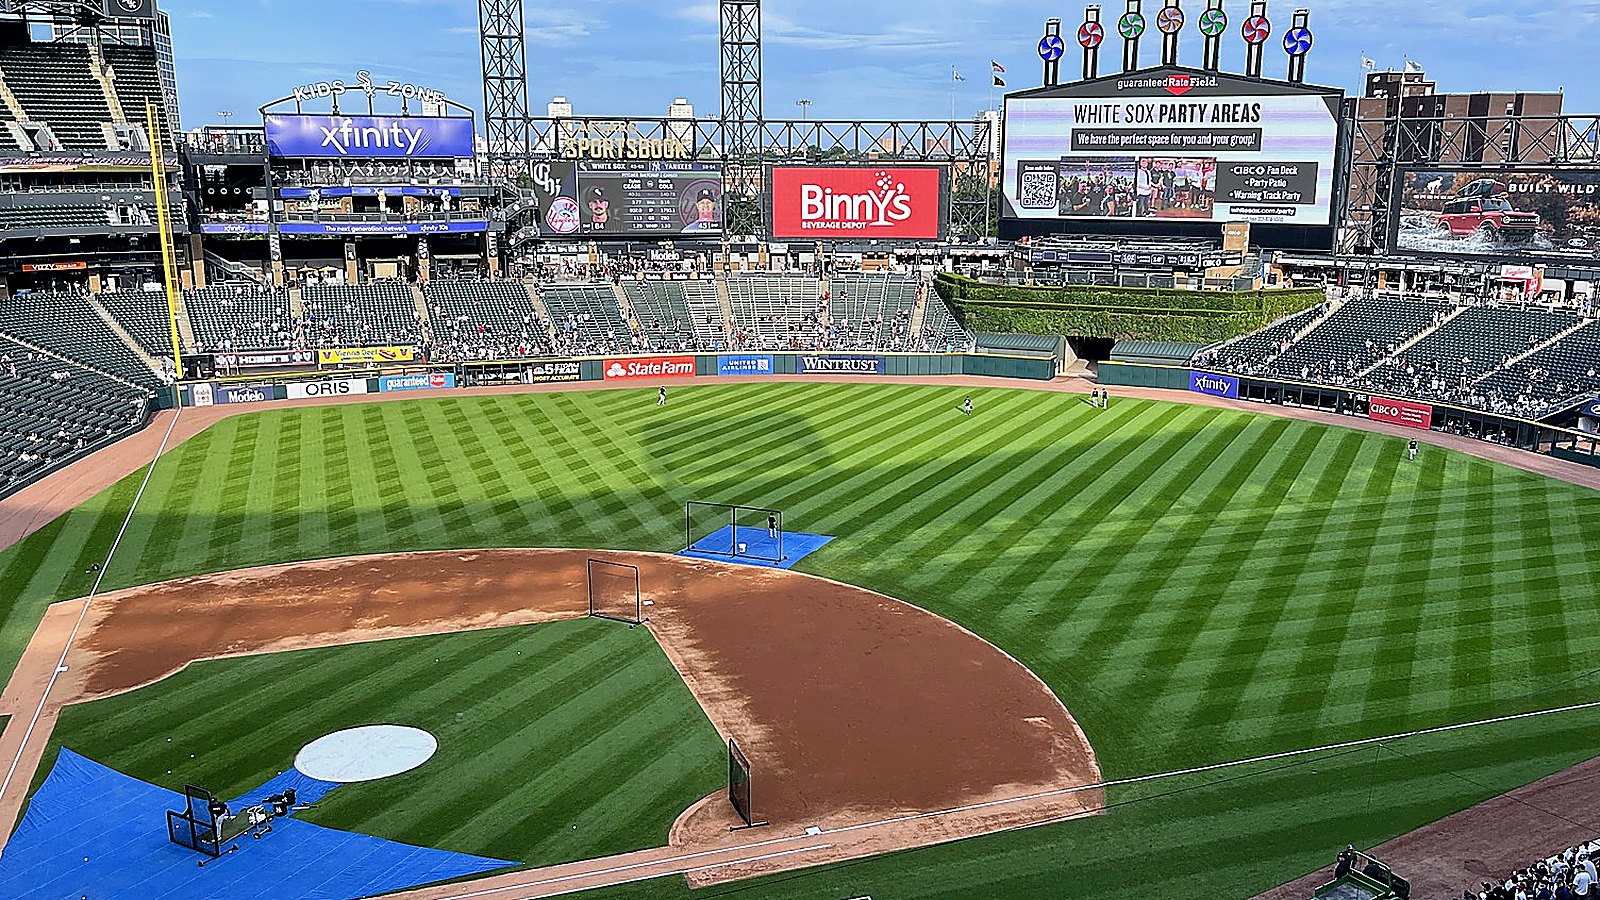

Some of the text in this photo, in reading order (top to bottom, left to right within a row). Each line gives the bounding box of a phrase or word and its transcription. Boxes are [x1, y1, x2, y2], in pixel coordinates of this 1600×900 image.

[1117, 77, 1168, 90] guaranteed
[1168, 77, 1188, 87] Rate
[294, 80, 447, 105] KIDS ZONE
[1074, 103, 1260, 123] WHITE SOX PARTY AREAS
[320, 119, 423, 155] xfinity
[1077, 133, 1256, 147] We have the perfect space for you and your group!
[566, 138, 690, 159] SPORTSBOOK
[1233, 166, 1298, 175] CIBC Fan Deck
[1249, 178, 1287, 188] Party Patio
[1508, 183, 1552, 193] BUILT
[1234, 190, 1302, 202] Warning Track Party
[650, 249, 679, 261] Modelo
[31, 263, 55, 271] VIZZY
[545, 363, 554, 375] 5
[627, 361, 693, 375] State Farm
[802, 356, 879, 371] WINTRUST
[305, 381, 350, 396] ORIS
[386, 375, 430, 391] guaranteed
[1194, 375, 1232, 394] xfinity
[228, 388, 265, 403] Modelo
[1371, 404, 1390, 415] CIBC
